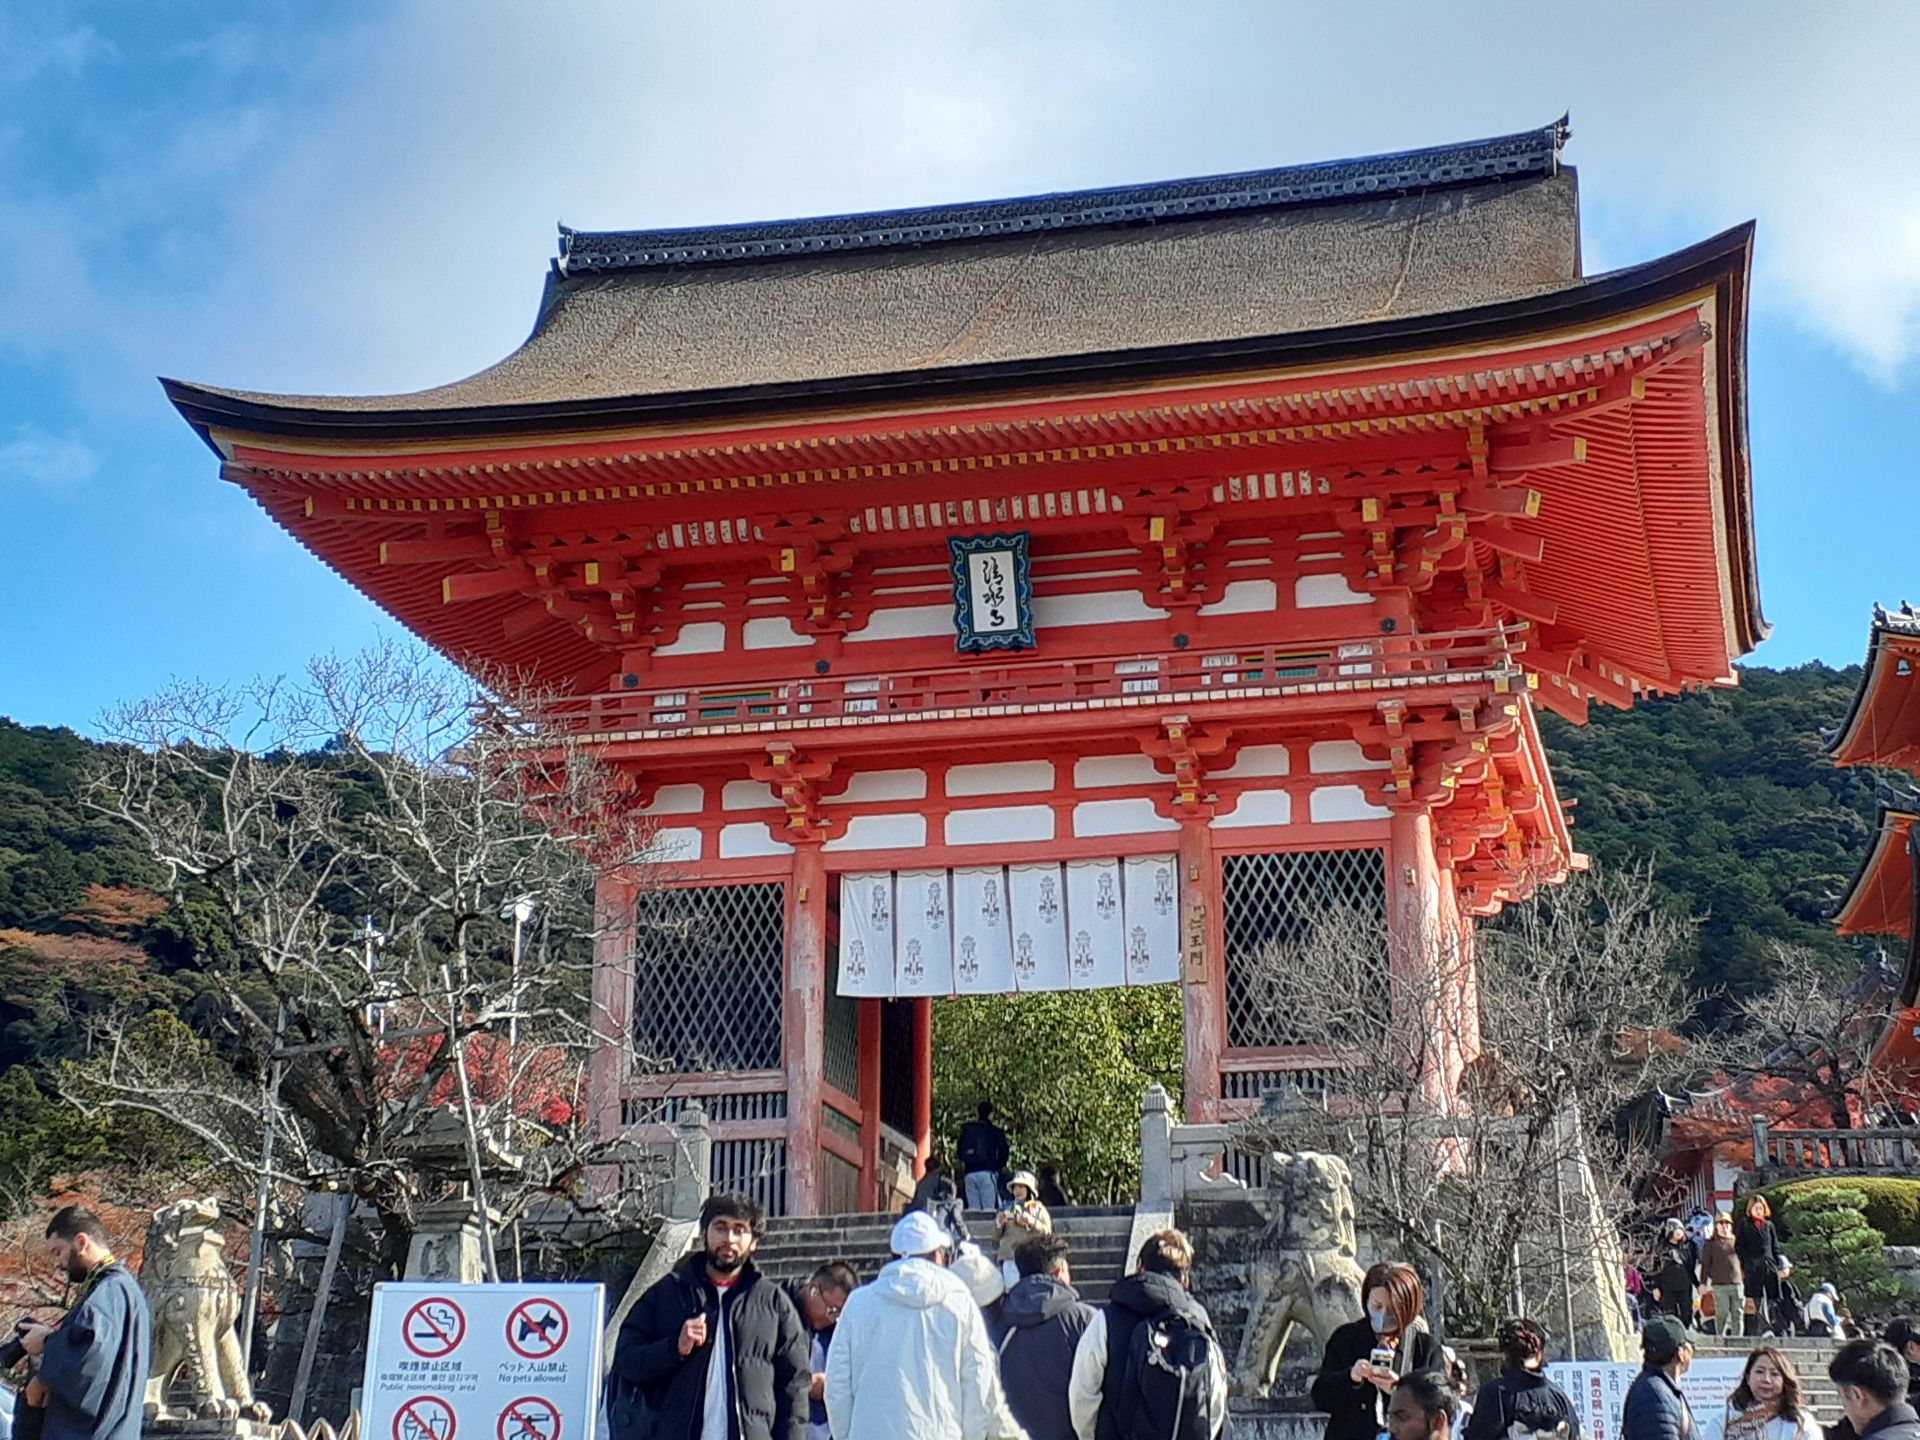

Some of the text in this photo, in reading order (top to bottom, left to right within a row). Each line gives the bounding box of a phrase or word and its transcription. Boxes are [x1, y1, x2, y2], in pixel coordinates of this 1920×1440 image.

[498, 1373, 566, 1384] No pets allowed
[380, 1383, 404, 1391] Public
